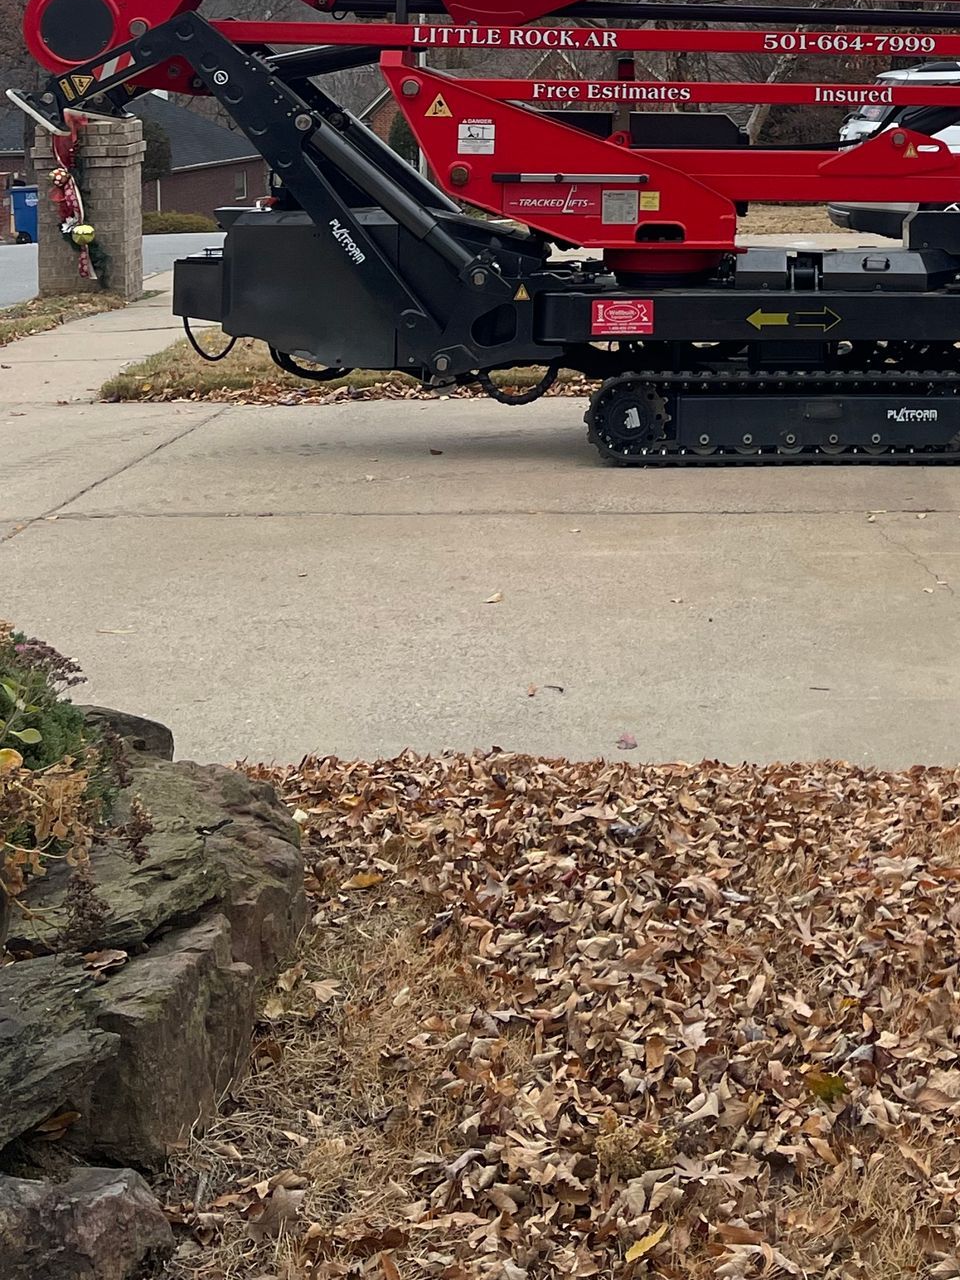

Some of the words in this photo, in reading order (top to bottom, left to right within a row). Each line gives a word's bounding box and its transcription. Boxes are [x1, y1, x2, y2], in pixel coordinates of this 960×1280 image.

[413, 27, 501, 45] LITTLE
[508, 29, 580, 48] ROCK,
[584, 31, 618, 48] AR
[763, 34, 936, 52] 501-664-7999
[532, 83, 580, 99] Free
[587, 83, 691, 100] Estimates
[815, 86, 893, 103] Insured
[329, 218, 366, 265] PLATFORM
[887, 406, 938, 421] PLATFORM
